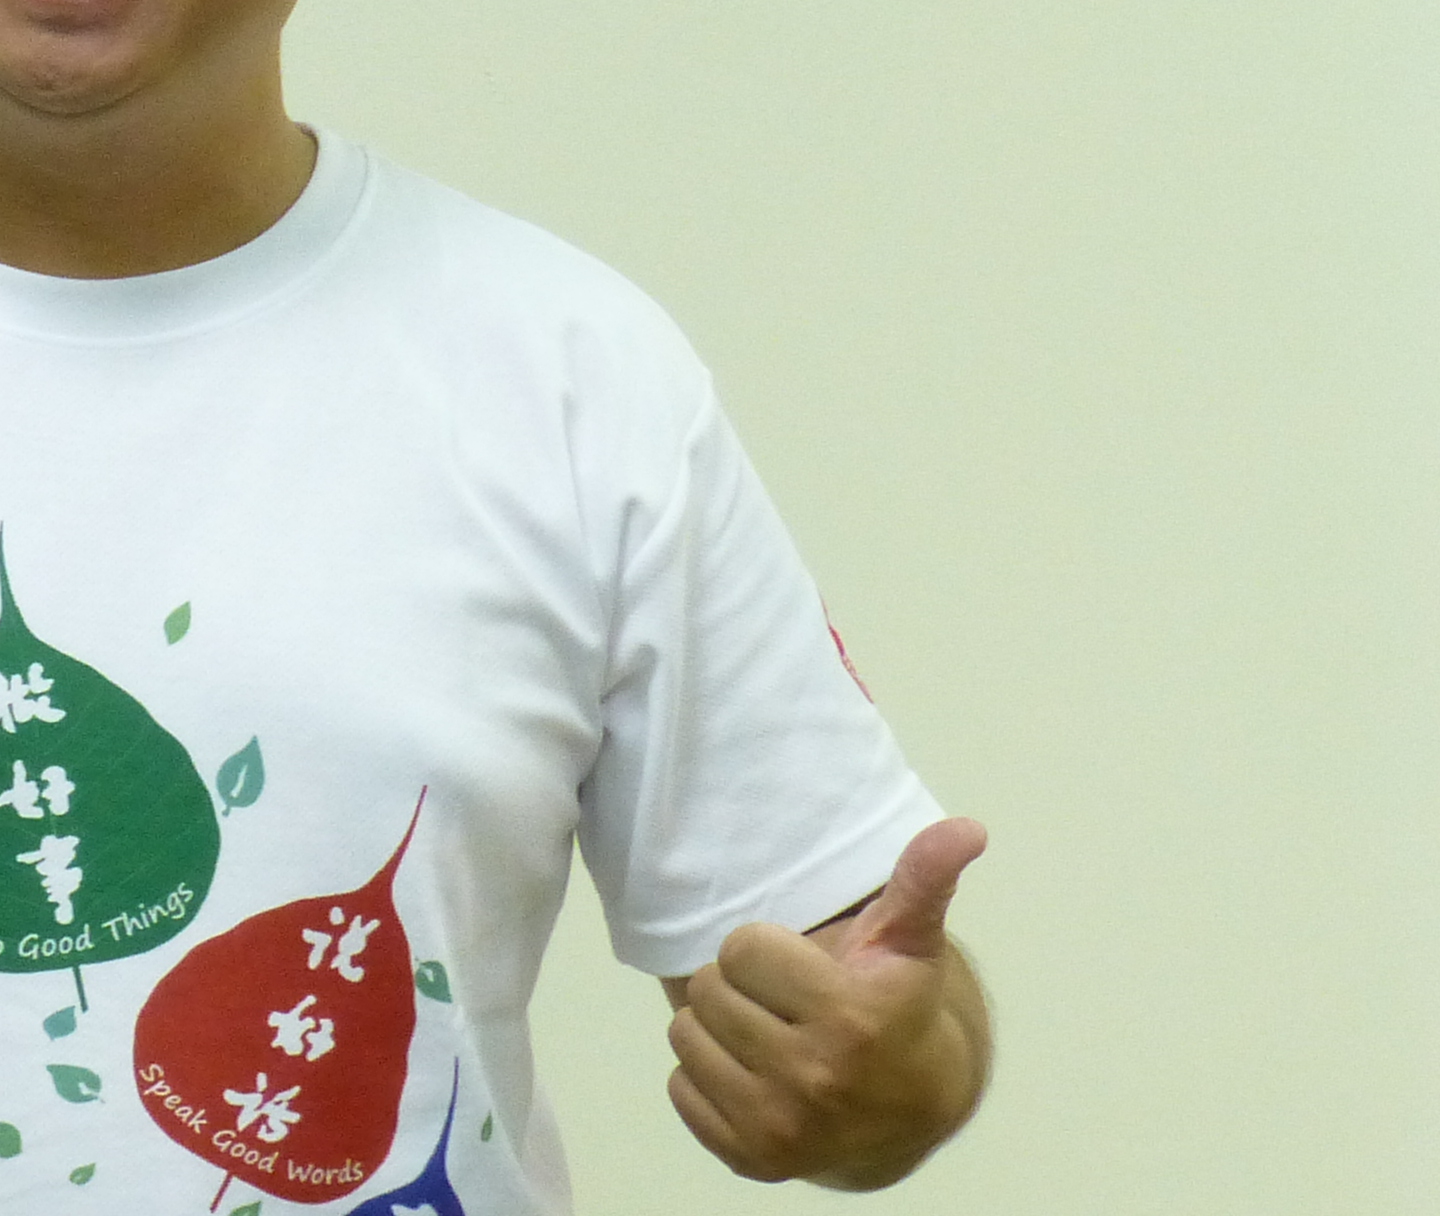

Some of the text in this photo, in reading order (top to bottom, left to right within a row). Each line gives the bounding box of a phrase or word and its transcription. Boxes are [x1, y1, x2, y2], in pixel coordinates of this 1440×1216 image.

[17, 924, 95, 960] Good
[101, 882, 194, 942] Things
[138, 1063, 365, 1185] Speak Good Words
